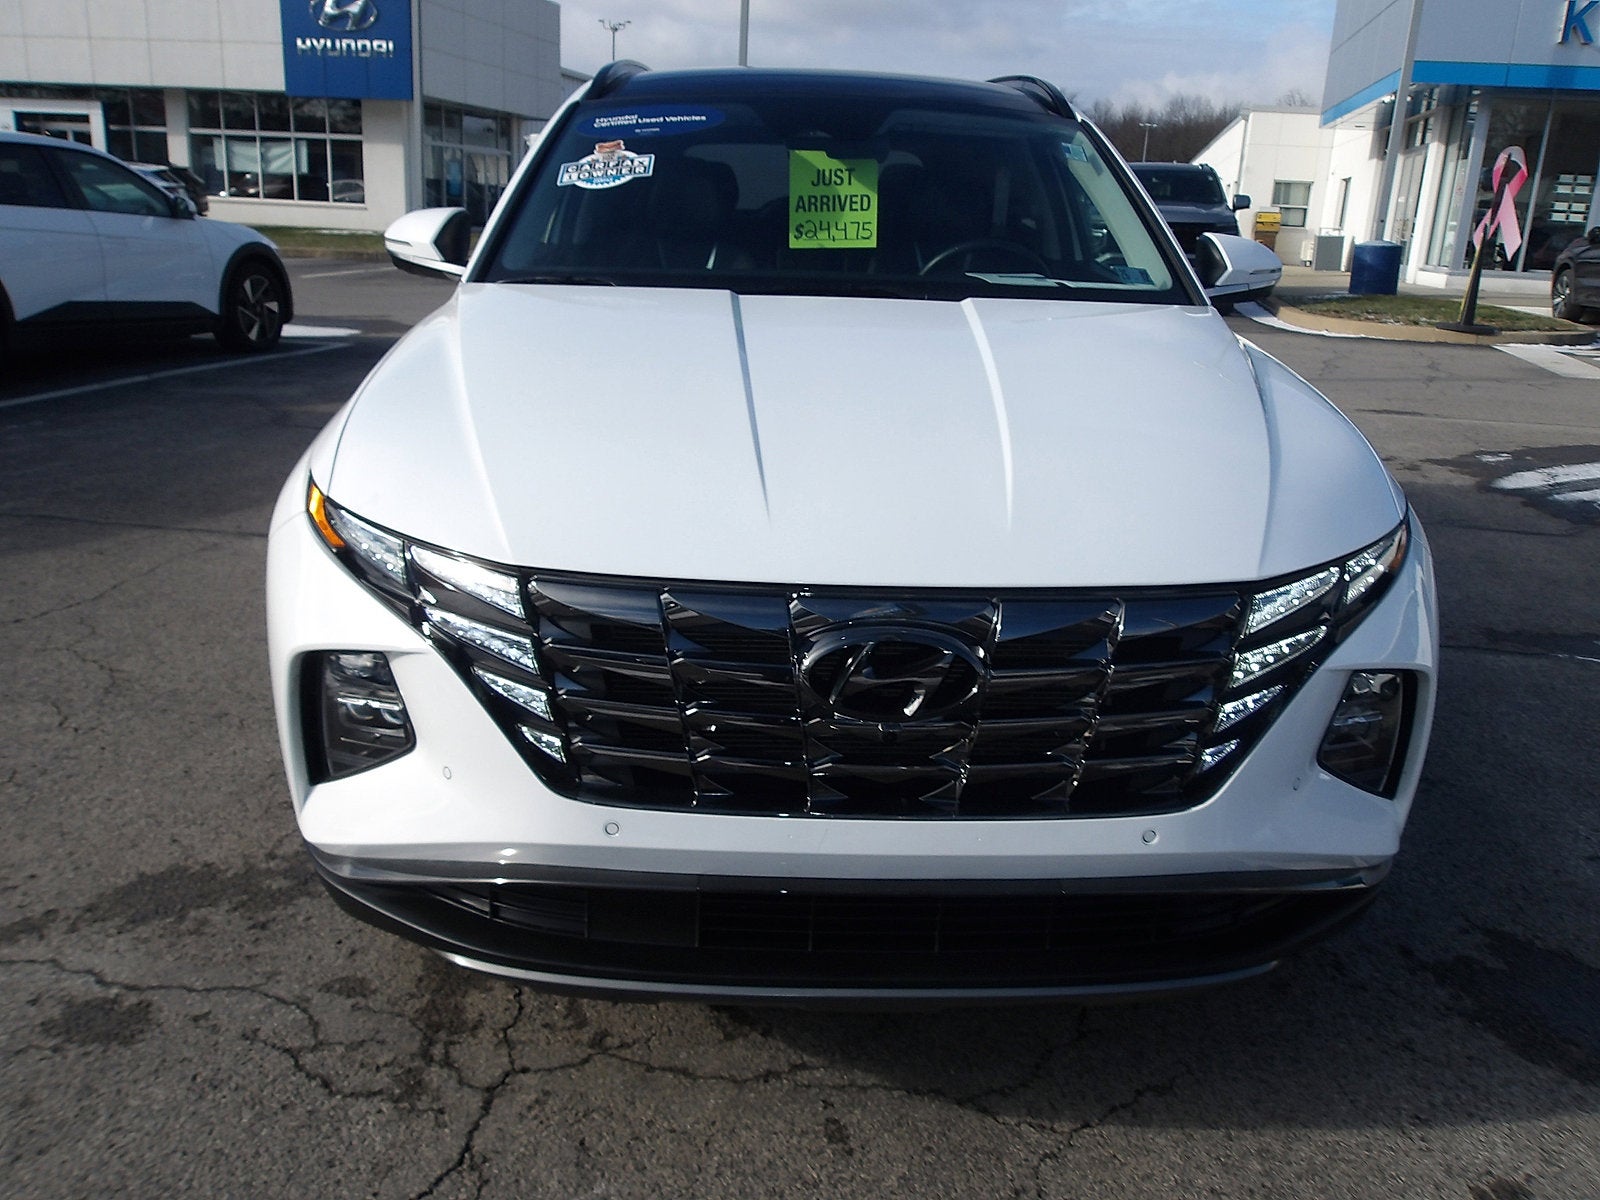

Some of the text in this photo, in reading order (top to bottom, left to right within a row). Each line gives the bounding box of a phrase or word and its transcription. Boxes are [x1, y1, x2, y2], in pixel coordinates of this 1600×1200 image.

[1560, 0, 1599, 45] K
[296, 37, 394, 57] HYUNDAI
[593, 119, 636, 128] Certified
[638, 116, 664, 124] Used
[595, 114, 638, 123] Hyundai
[579, 166, 646, 180] OWNER
[811, 168, 856, 186] JUST
[795, 194, 871, 212] ARRIVED
[794, 220, 873, 242] $24,475
